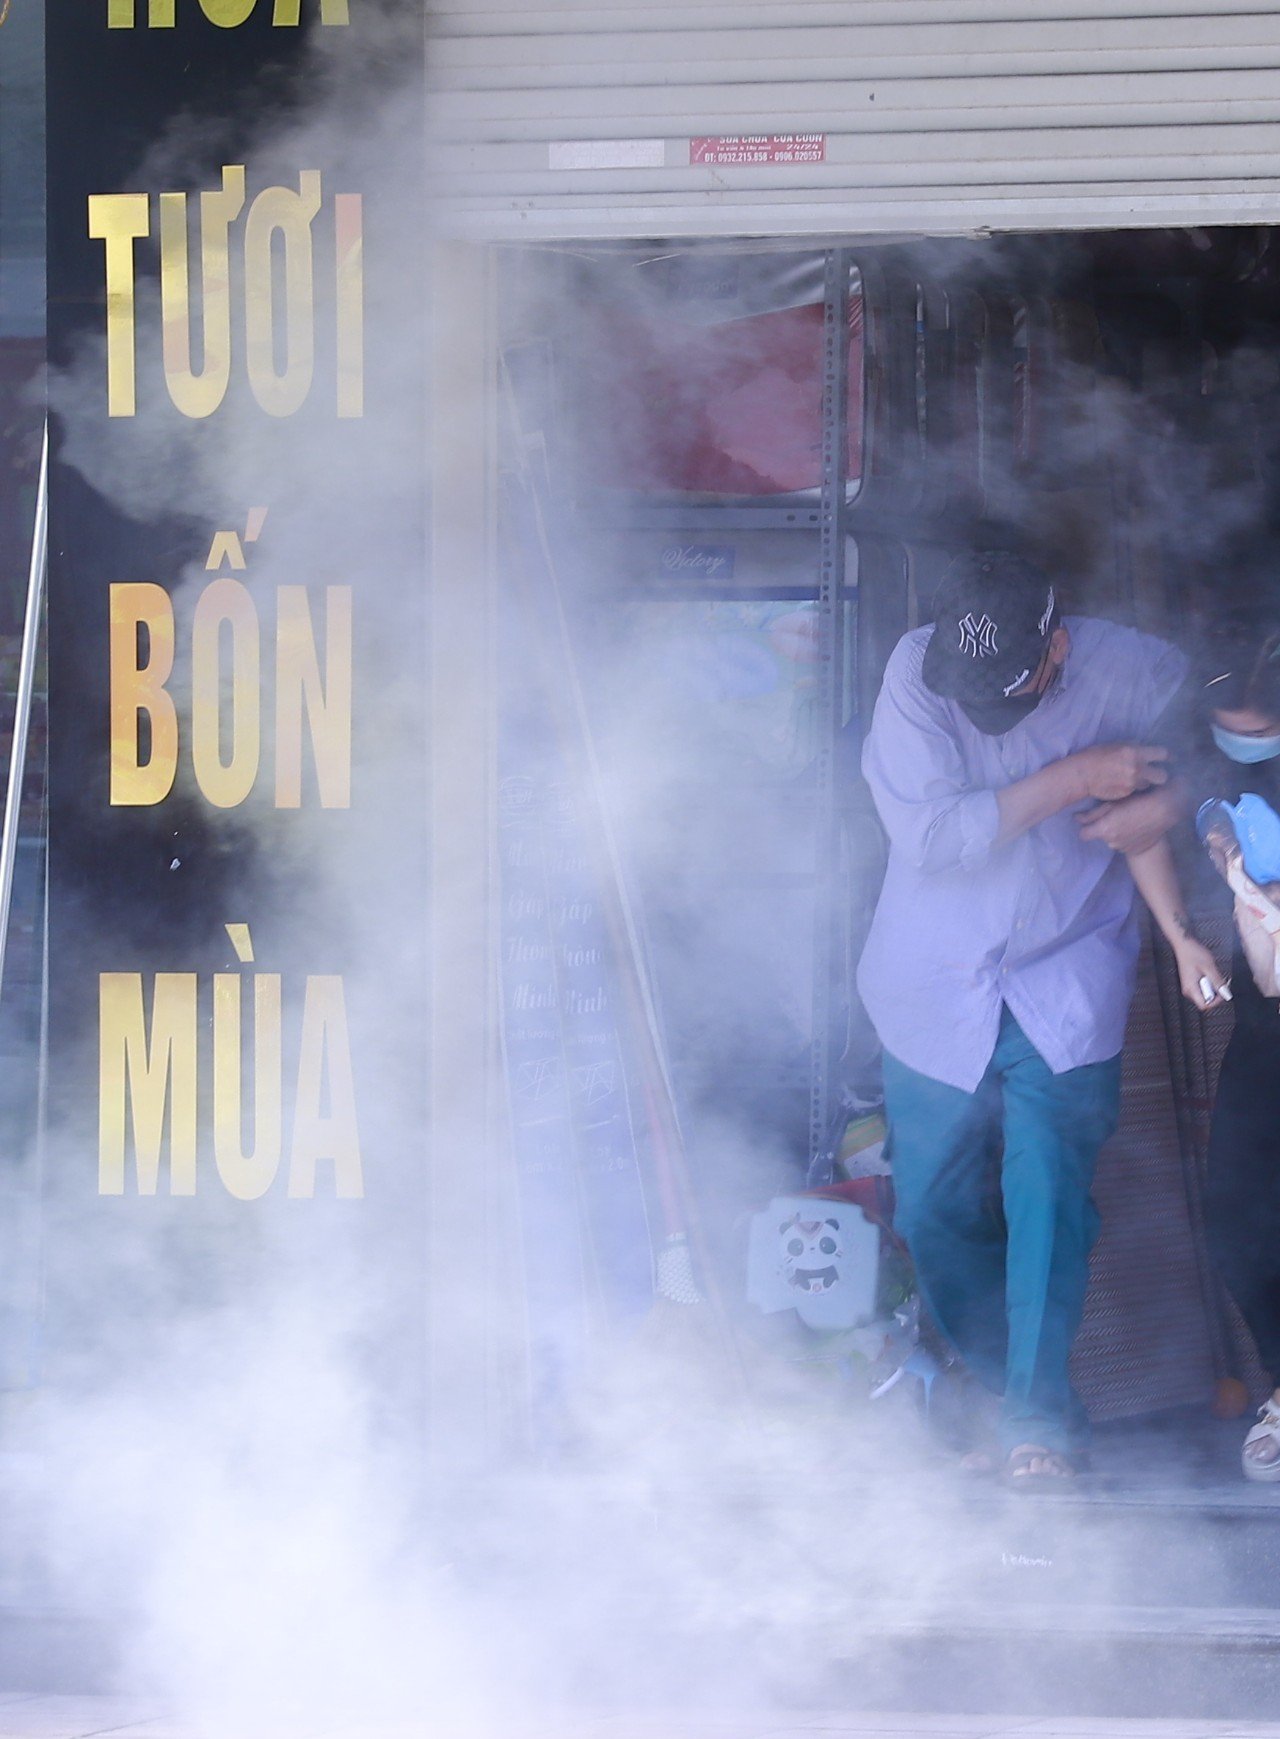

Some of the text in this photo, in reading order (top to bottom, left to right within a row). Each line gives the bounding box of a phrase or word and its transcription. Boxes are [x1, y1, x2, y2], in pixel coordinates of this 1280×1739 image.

[88, 165, 363, 418] TƯƠI
[109, 507, 352, 808] BỐN
[958, 612, 999, 658] NY
[98, 924, 365, 1200] MÙA
